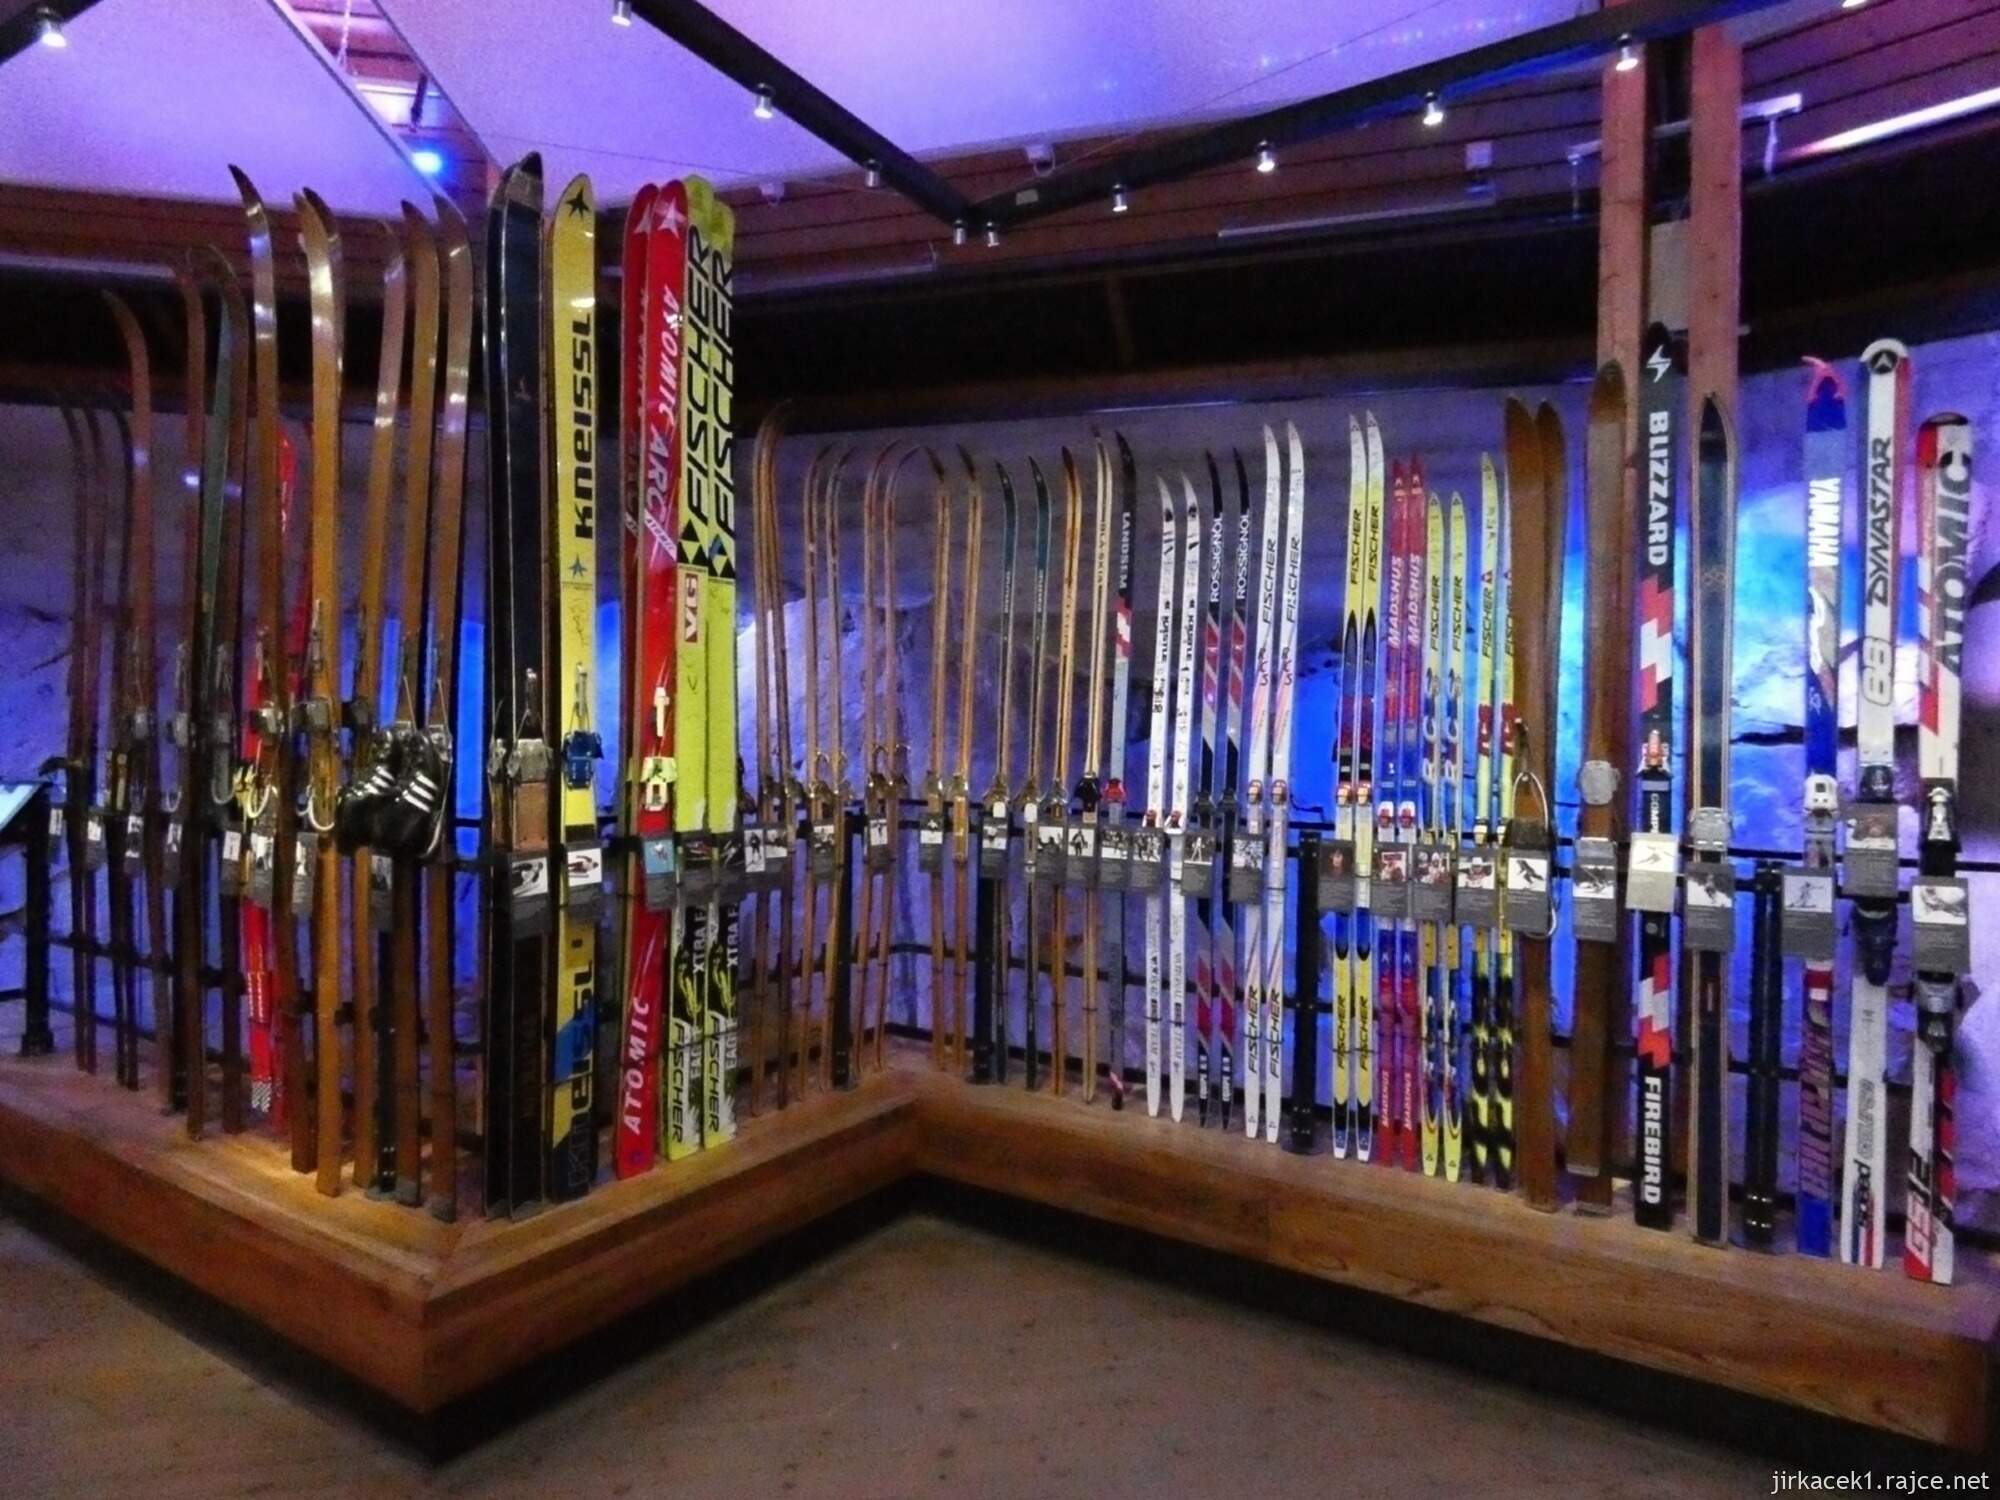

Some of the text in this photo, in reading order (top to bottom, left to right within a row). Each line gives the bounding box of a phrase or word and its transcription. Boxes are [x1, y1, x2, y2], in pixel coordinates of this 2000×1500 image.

[645, 284, 680, 525] ATOMIC ARC
[687, 224, 709, 526] FISCHER
[712, 250, 735, 541] FISCHER
[1648, 411, 1669, 566] BLIZZARD
[1808, 476, 1841, 568] YAMAHA
[1867, 436, 1894, 607] DYNASTAR
[1119, 511, 1131, 590] LANDSEM
[1210, 512, 1223, 603] ROSSIGNOL
[1236, 509, 1250, 600] ROSSIGNOL
[1262, 538, 1276, 625] FISCHER
[1286, 536, 1300, 624] FISCHER
[1350, 508, 1362, 586] FISCHER
[1368, 504, 1380, 583] FISCHER
[1934, 449, 1971, 680] ATOMIC
[1388, 555, 1403, 648] MADSHUS
[1407, 552, 1422, 647] MADSHUS
[1431, 575, 1441, 652] FISCHER
[1453, 575, 1463, 652] FISCHER
[1482, 587, 1493, 658] FISCHER
[693, 926, 706, 974] XTRA
[727, 921, 739, 968] XTRA
[623, 996, 650, 1137] ATOMIC
[708, 1013, 720, 1133] FISCHER
[1249, 984, 1258, 1075] FISCHER
[1270, 988, 1280, 1079] FISCHER
[1338, 994, 1347, 1070] FISCHER
[1359, 995, 1369, 1073] FISCHER
[673, 1020, 685, 1144] FISCHER
[1644, 1075, 1662, 1204] FIREBIRD
